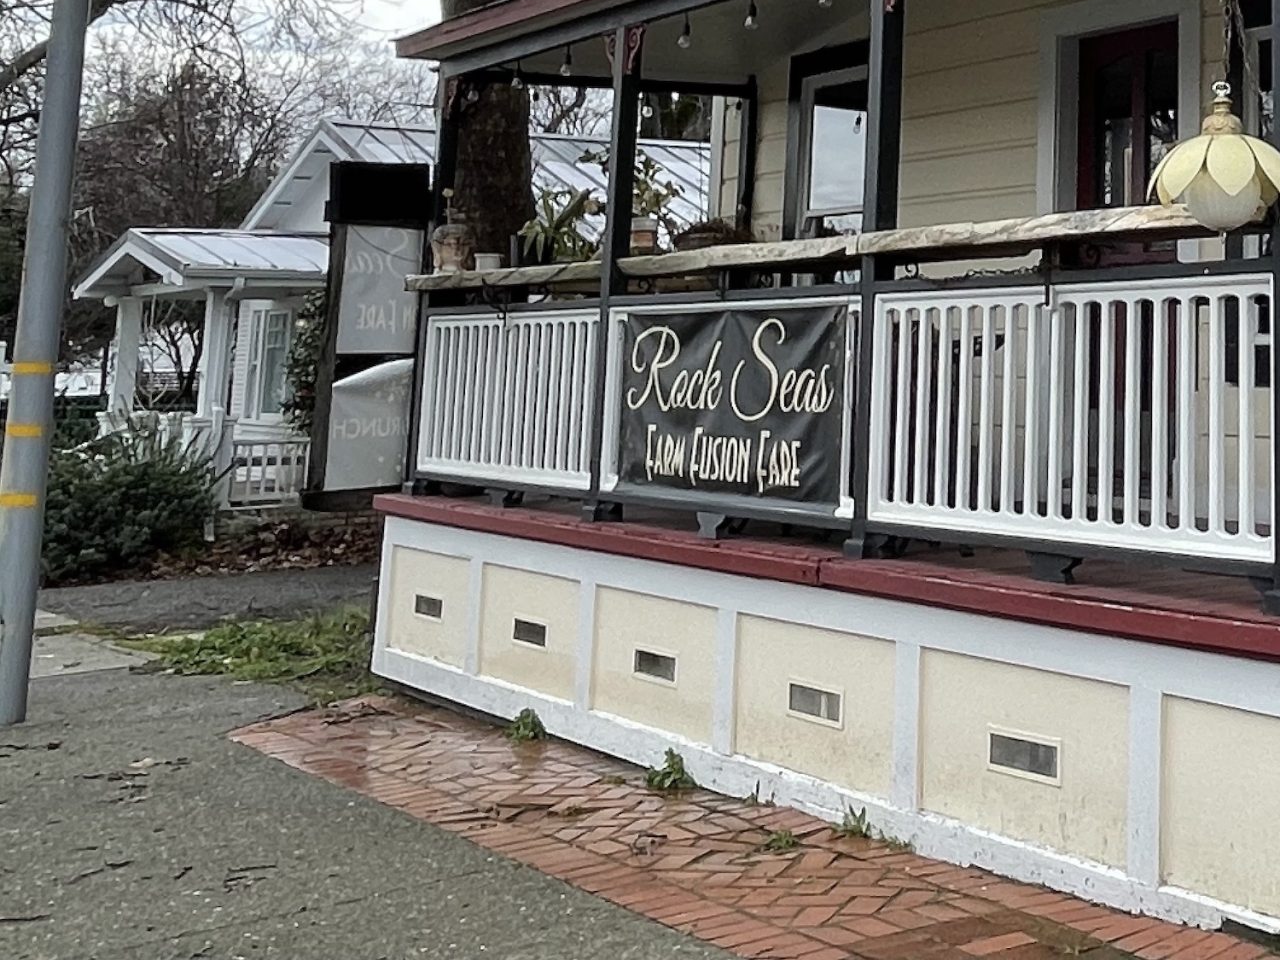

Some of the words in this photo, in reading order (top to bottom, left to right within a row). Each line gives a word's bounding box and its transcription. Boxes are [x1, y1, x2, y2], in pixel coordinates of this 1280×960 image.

[627, 326, 722, 412] Rock
[730, 318, 835, 421] Seas
[645, 424, 686, 481] FARM
[690, 427, 751, 486] FUSION
[757, 430, 801, 493] FARE
